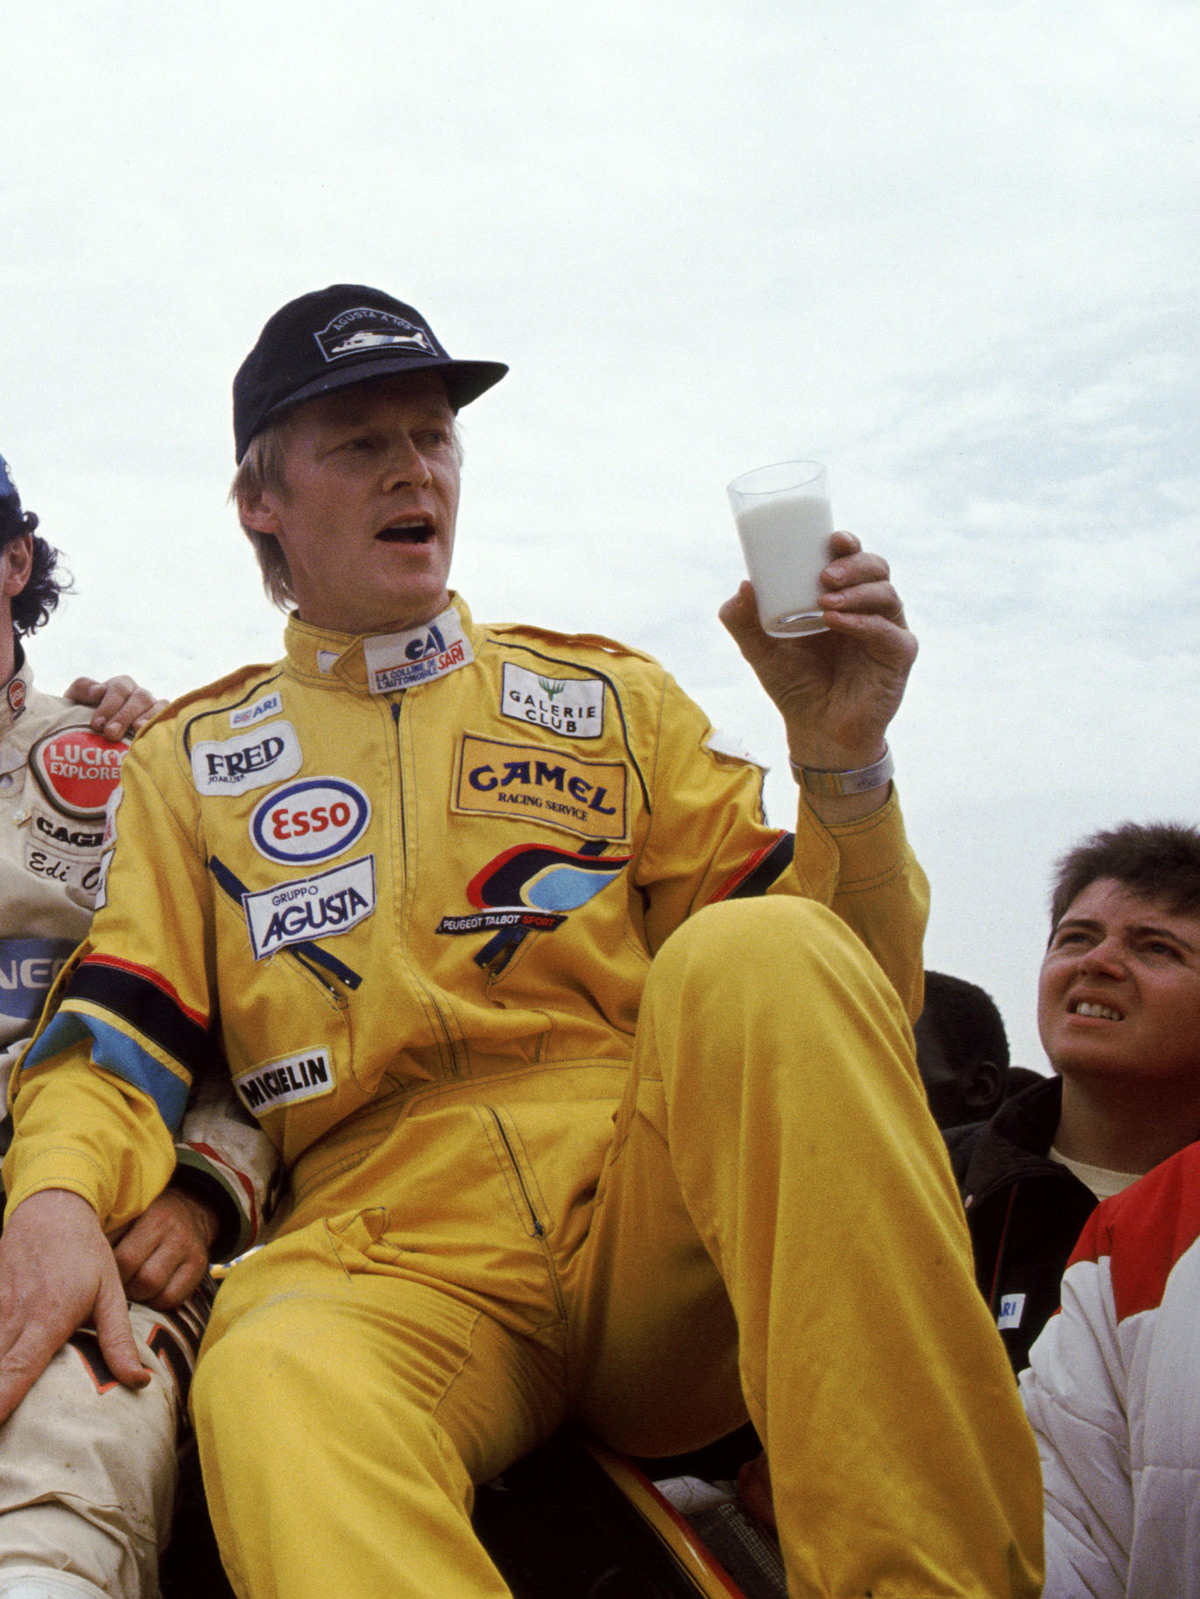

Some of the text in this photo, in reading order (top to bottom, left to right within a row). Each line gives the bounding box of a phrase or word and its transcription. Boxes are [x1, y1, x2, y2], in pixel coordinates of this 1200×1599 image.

[333, 311, 377, 331] AGUSTA
[438, 644, 466, 671] SARI
[253, 698, 278, 719] ARI
[509, 690, 597, 719] GALERIE
[525, 709, 577, 733] CLUB
[50, 744, 129, 766] LUCKY
[206, 737, 285, 776] FRED
[50, 762, 122, 781] EXPLORE
[469, 761, 616, 815] CAMEL
[498, 791, 589, 822] RACING SERVICE
[29, 852, 71, 882] Edi
[272, 885, 319, 906] GRUPPO
[262, 886, 369, 948] AGUSTA
[443, 914, 556, 931] PEUGEOT TALBOT SPORT
